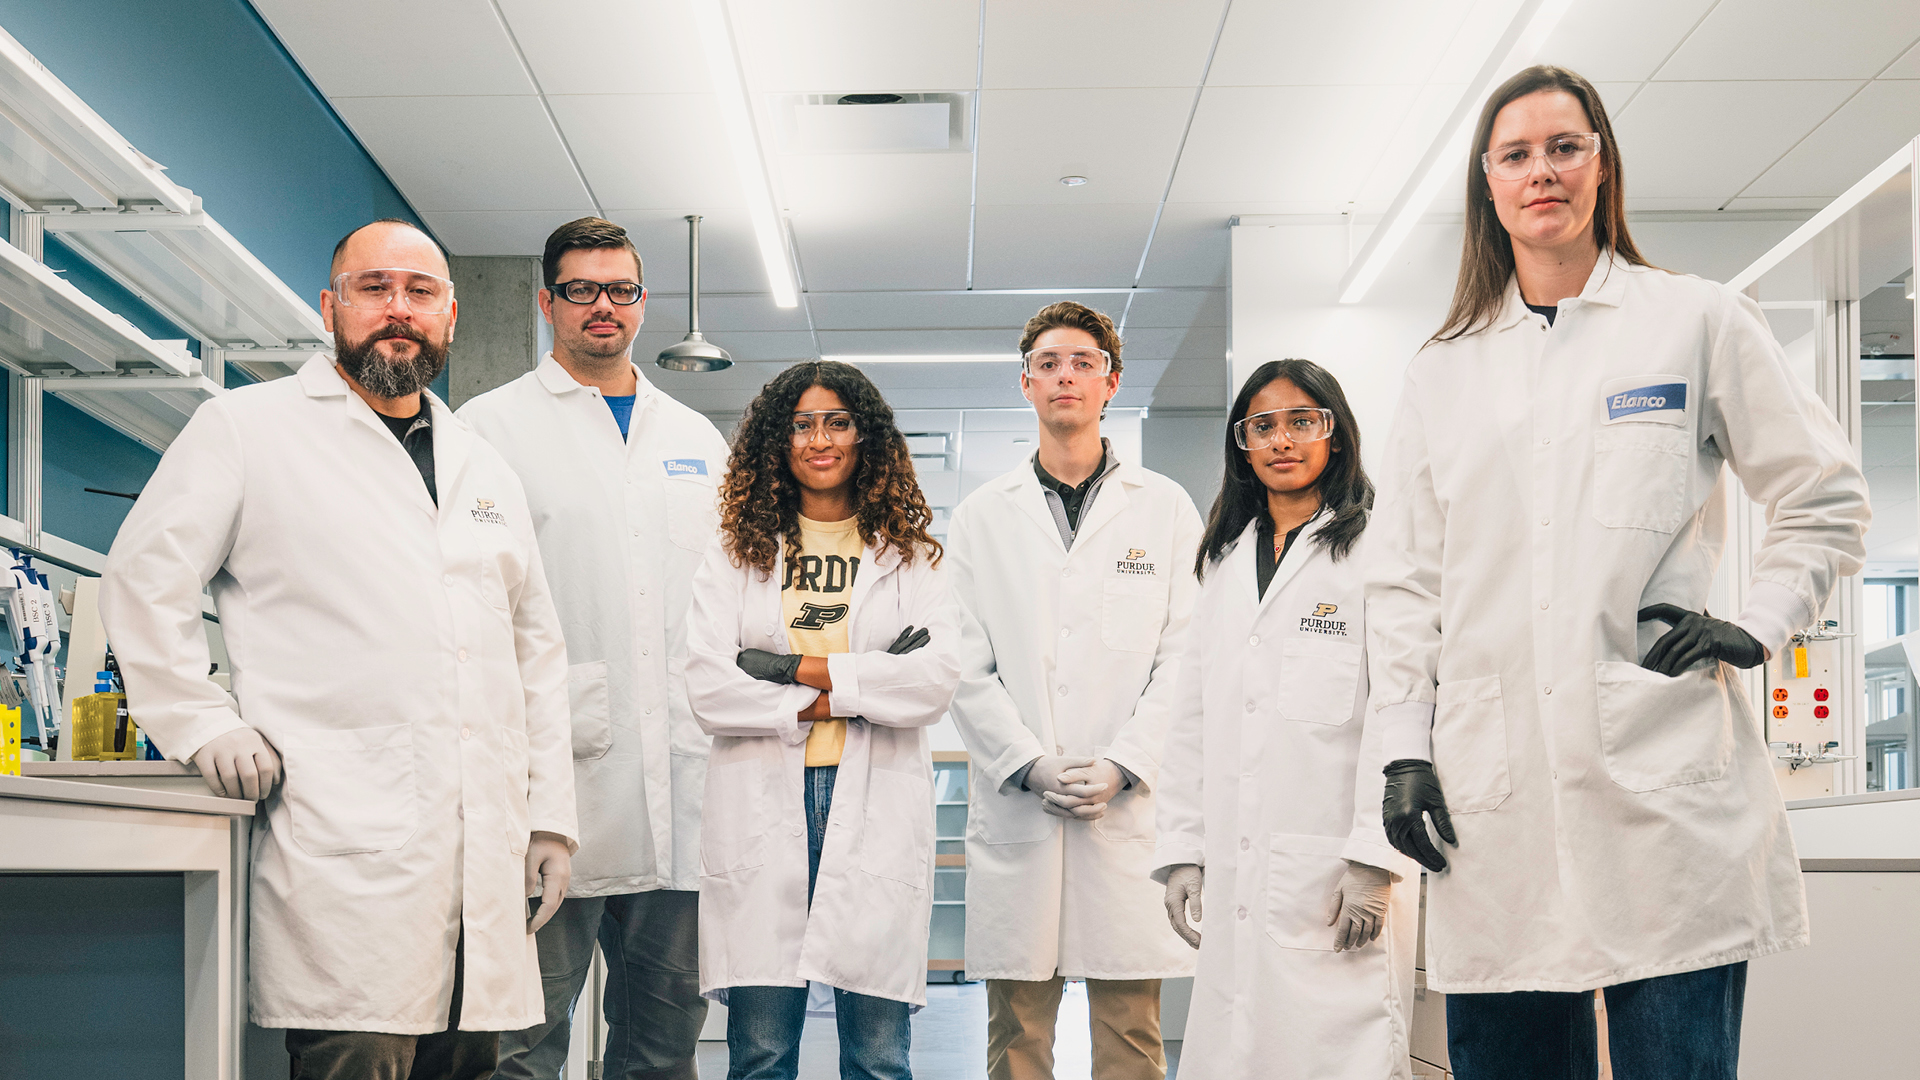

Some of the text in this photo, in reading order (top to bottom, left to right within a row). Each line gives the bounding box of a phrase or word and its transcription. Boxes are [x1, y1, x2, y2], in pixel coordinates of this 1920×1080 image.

[1611, 394, 1666, 410] Elanco
[667, 461, 698, 474] Elanco
[1117, 561, 1155, 571] PURDUE
[31, 605, 40, 623] BSC
[44, 609, 53, 626] BSC
[1300, 617, 1346, 631] PURDUE
[1299, 627, 1346, 636] UNIVERSITY
